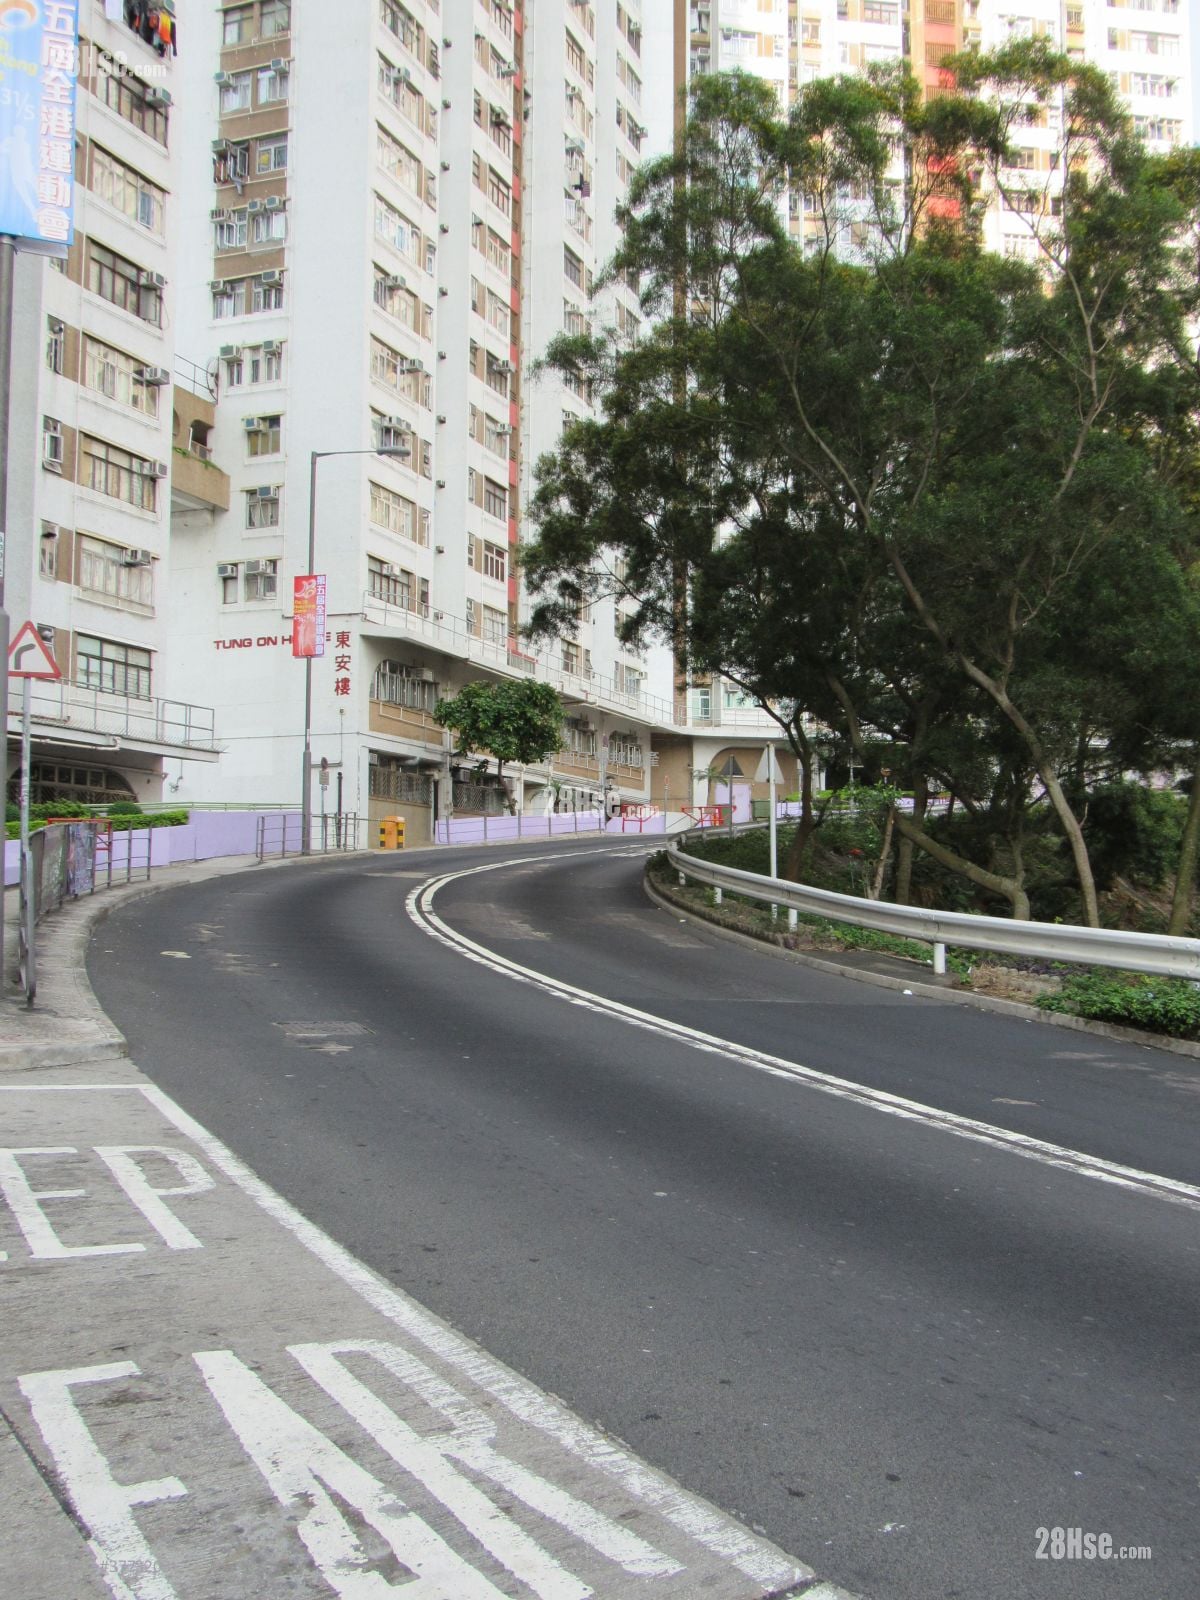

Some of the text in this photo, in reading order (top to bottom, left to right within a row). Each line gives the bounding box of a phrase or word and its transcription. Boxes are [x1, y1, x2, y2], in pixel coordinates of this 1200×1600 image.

[213, 638, 252, 650] TUNG
[256, 636, 278, 647] ON
[334, 630, 351, 696] 東安樓
[0, 1145, 217, 1261] EP
